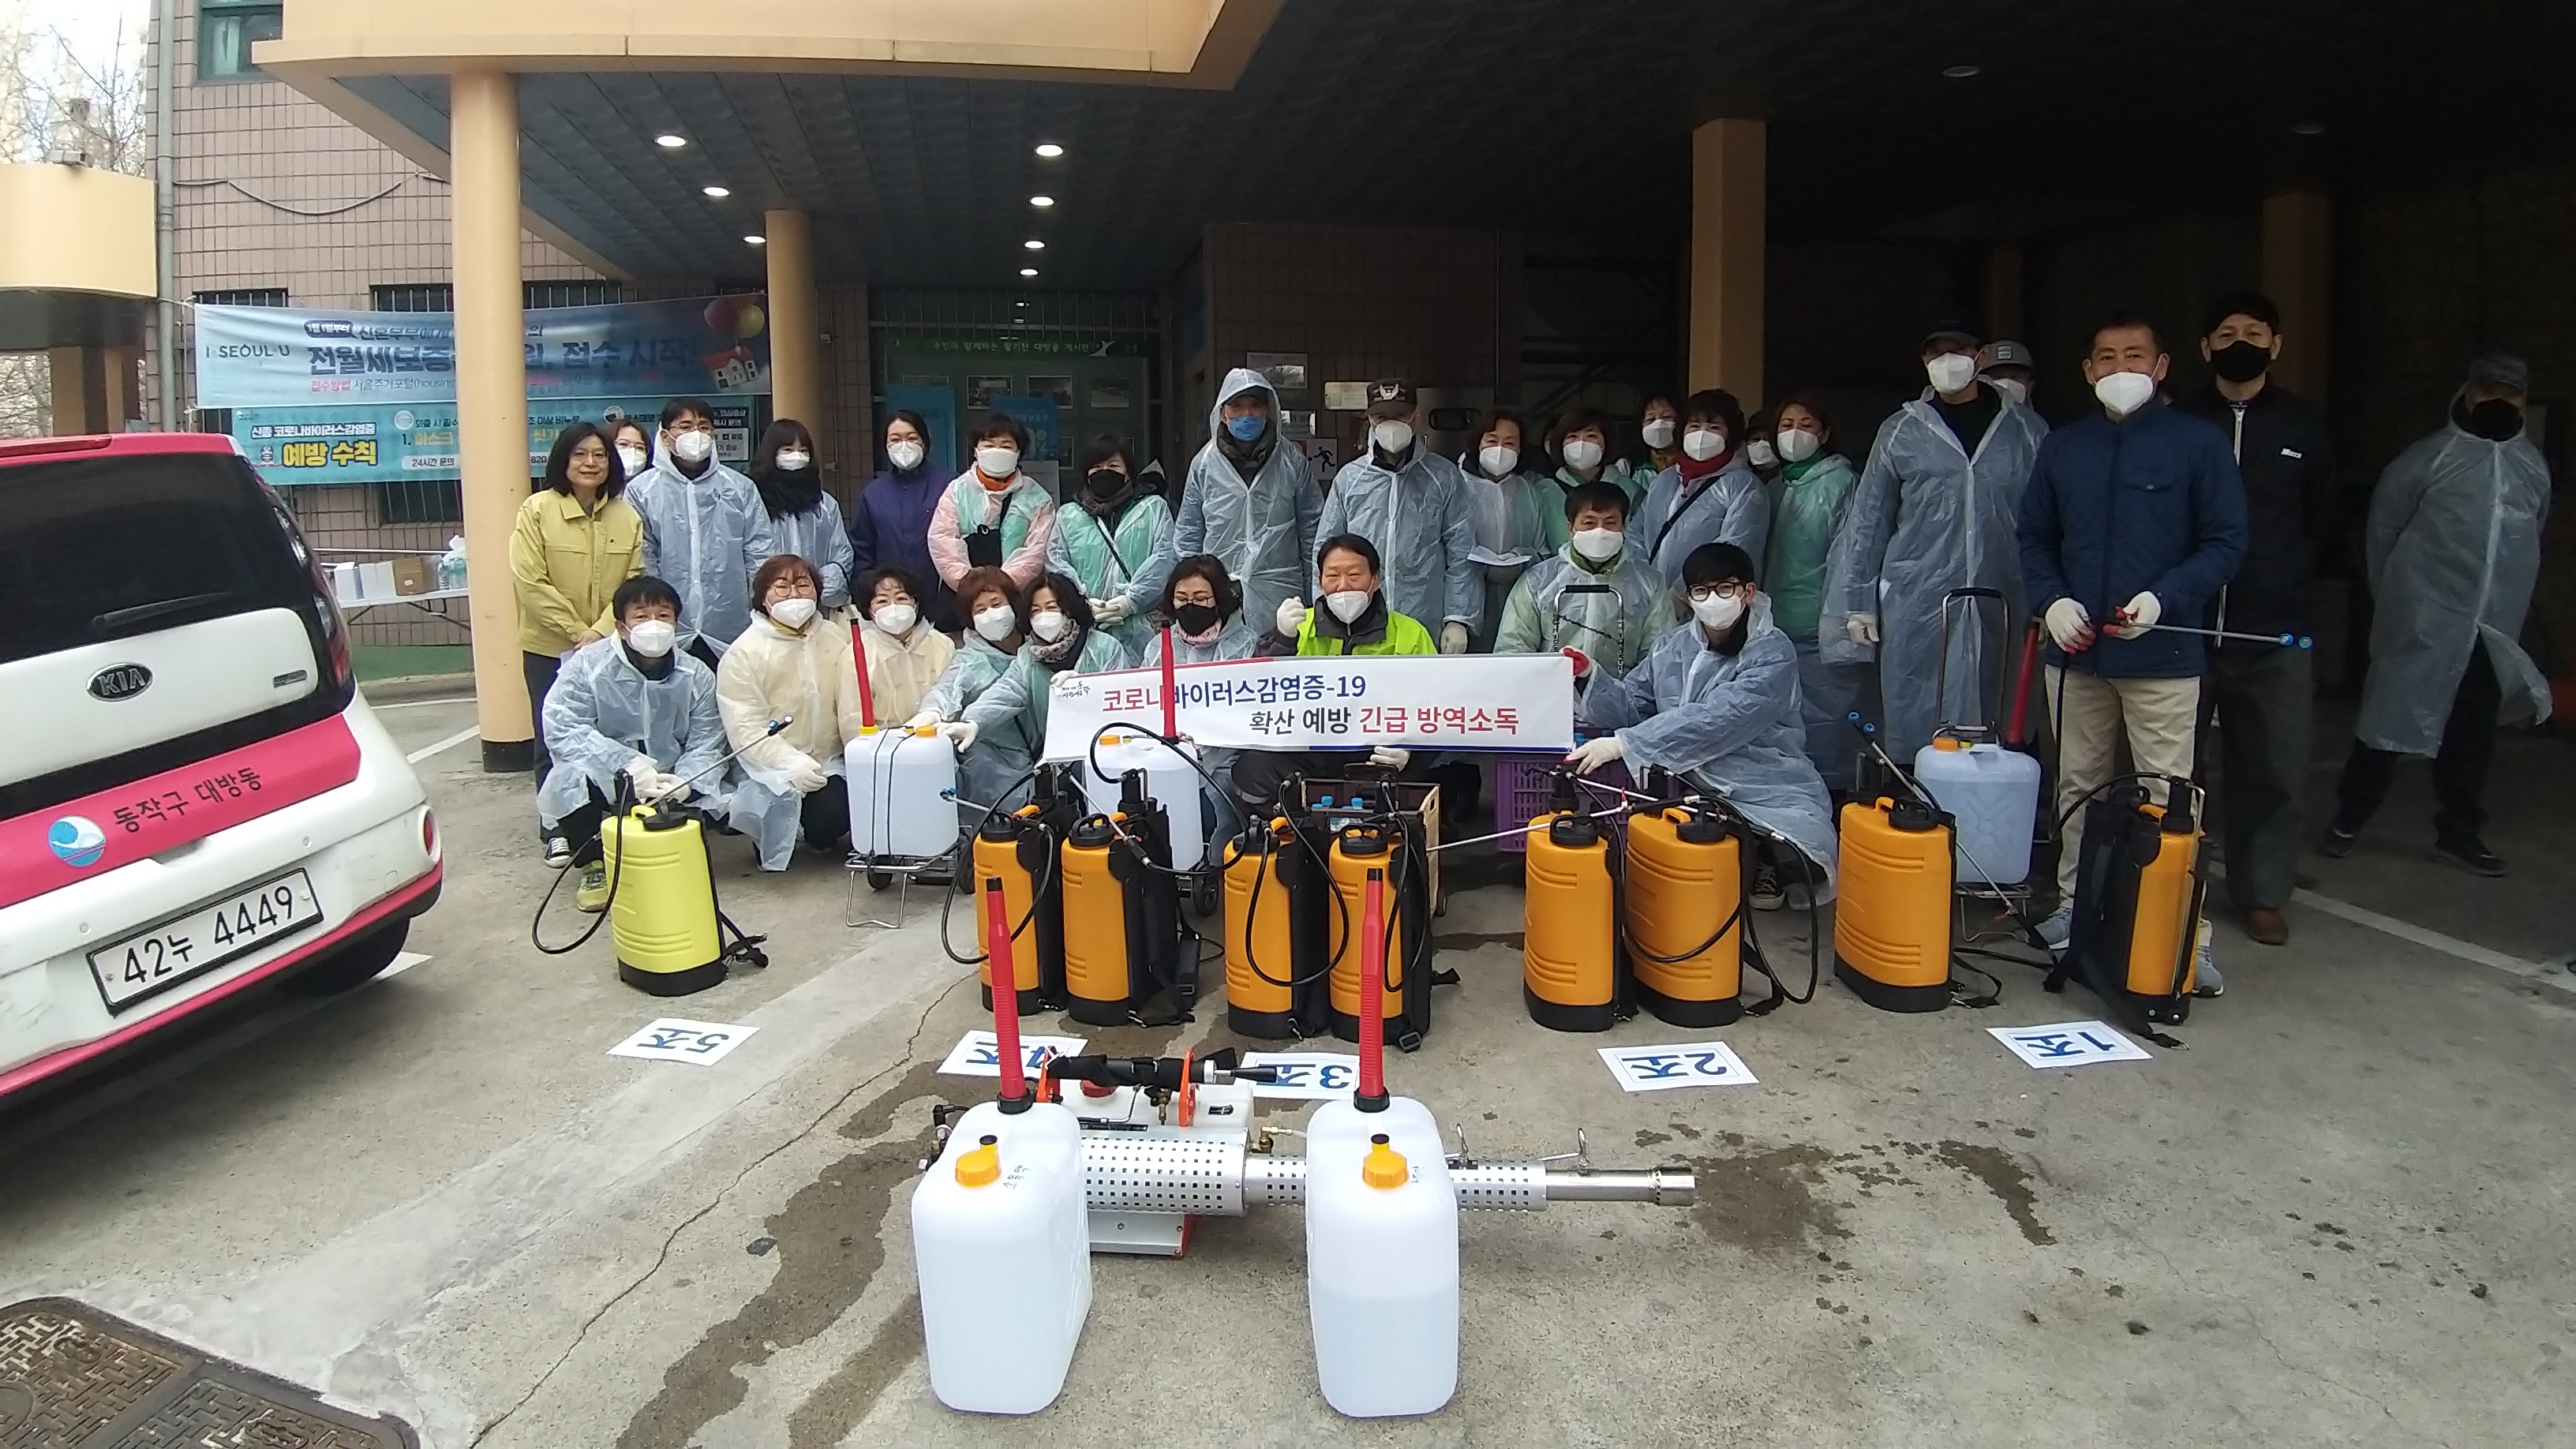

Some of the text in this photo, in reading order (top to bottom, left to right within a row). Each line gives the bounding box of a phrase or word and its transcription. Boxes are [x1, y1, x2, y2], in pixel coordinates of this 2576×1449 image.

[219, 343, 274, 358] SEOUL
[279, 345, 291, 357] U
[307, 345, 455, 376] 전월세보증
[561, 340, 621, 369] 접수
[311, 380, 351, 392] 접수방법
[251, 422, 376, 440] 신종 코로나바이러스감염증
[282, 440, 378, 468] 예방 수칙
[411, 458, 437, 467] 24시간
[440, 457, 455, 466] 문의
[97, 668, 144, 695] KIA
[1102, 675, 1366, 712] 코로나바이러스감염증-19
[1249, 706, 1519, 736] 확산 예방 긴급 방역소독
[114, 766, 262, 834] 동작구 대방동
[122, 885, 295, 986] 42누 4449
[636, 1026, 730, 1054] 5조
[2013, 1032, 2117, 1058] 1조
[1256, 1062, 1354, 1089] 3조
[1622, 1052, 1727, 1080] 2조
